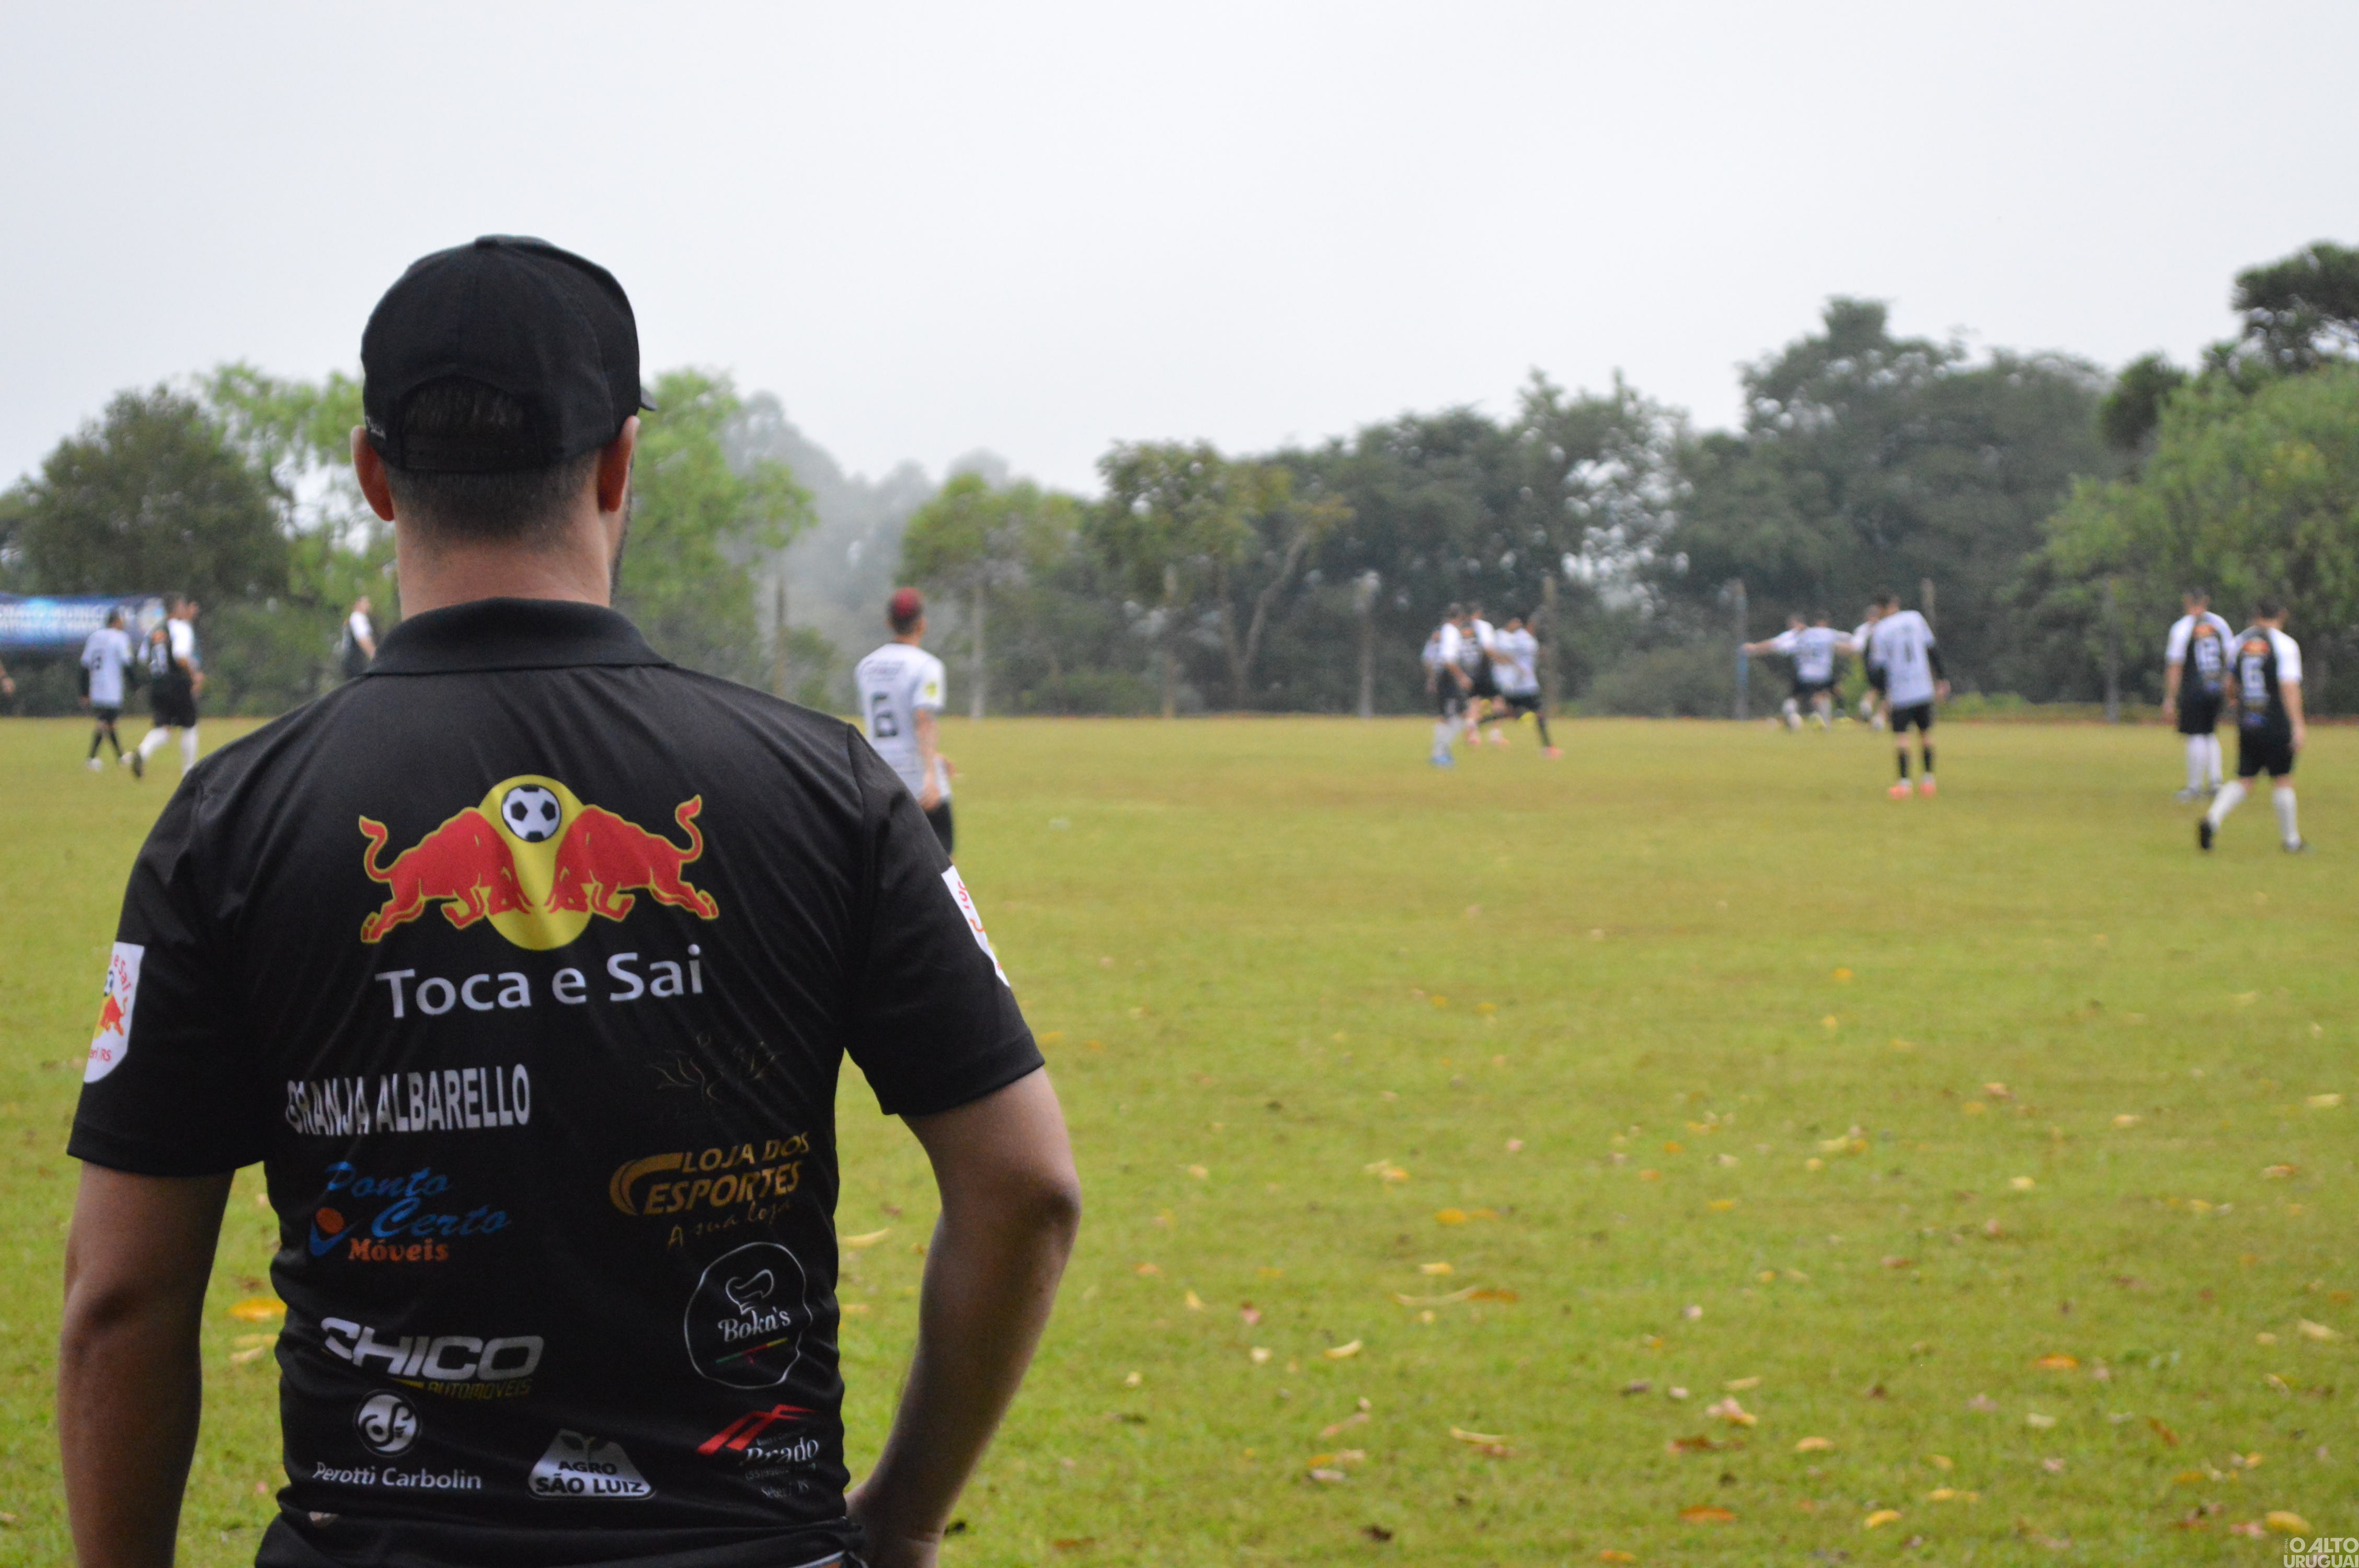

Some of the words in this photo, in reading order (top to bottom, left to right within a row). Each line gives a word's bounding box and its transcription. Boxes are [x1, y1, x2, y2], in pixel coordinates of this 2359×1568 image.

[375, 968, 532, 1018] Toca
[551, 967, 587, 1005] e
[606, 943, 703, 1002] Sai
[285, 1076, 370, 1136] GRANJA
[375, 1064, 530, 1133] ALBARELLO
[681, 1143, 755, 1173] LOJA
[762, 1131, 810, 1162] DOS
[325, 1160, 451, 1198] Ponto
[643, 1160, 804, 1215] ESPORTES
[371, 1196, 510, 1239] Certo
[348, 1237, 450, 1262] Móveis
[717, 1307, 792, 1343] Boka's
[320, 1317, 544, 1381] CHICO
[558, 1460, 617, 1475] AGRO
[745, 1436, 819, 1465] Prado
[312, 1461, 376, 1486] Perotti
[382, 1465, 482, 1490] Carbolin
[535, 1472, 585, 1494] SÃO
[592, 1478, 645, 1494] LUIZ
